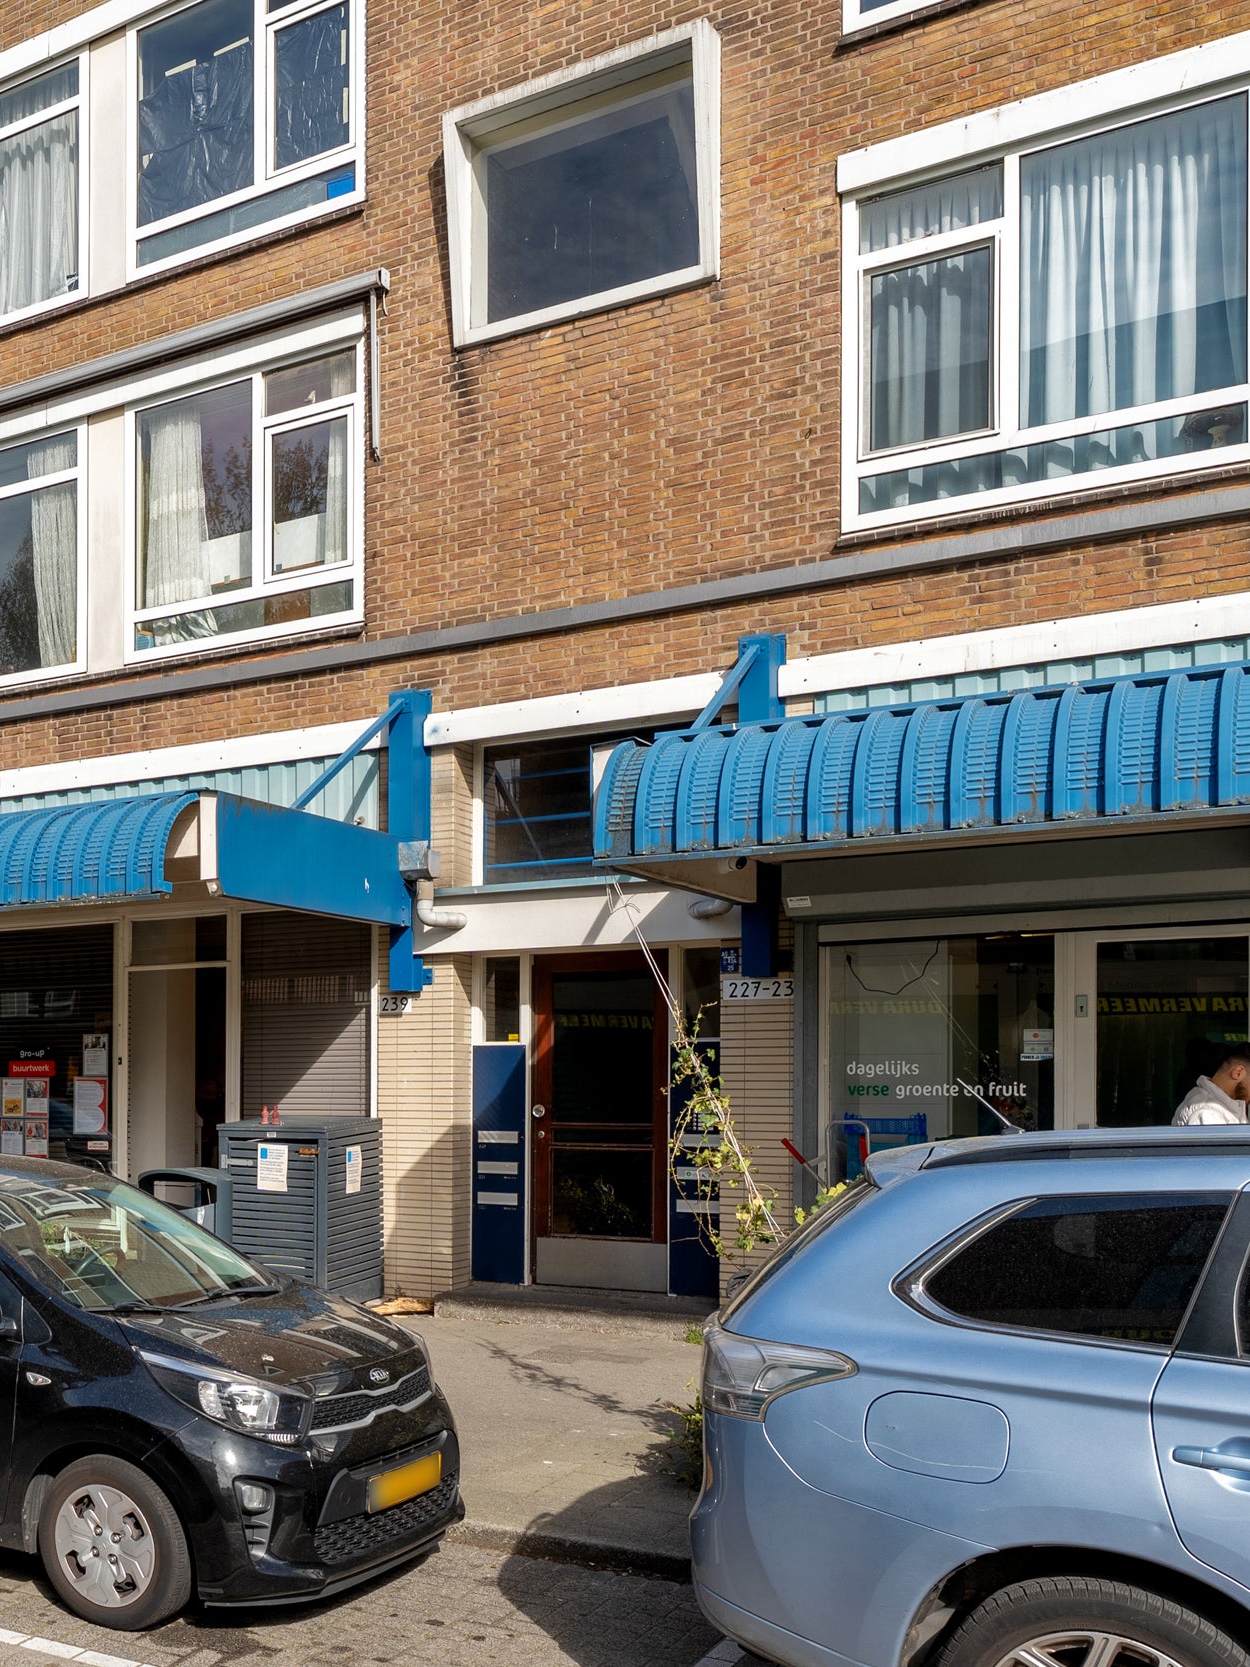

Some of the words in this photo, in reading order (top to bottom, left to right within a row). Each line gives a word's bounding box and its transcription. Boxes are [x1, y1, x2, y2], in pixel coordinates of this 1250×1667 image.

[381, 997, 408, 1011] 239
[20, 1049, 45, 1058] gro-up
[12, 1064, 50, 1072] buurtwerk
[846, 1061, 920, 1078] dagelijks
[847, 1084, 890, 1096] verse
[896, 1083, 959, 1099] groente
[988, 1081, 1027, 1097] fruit
